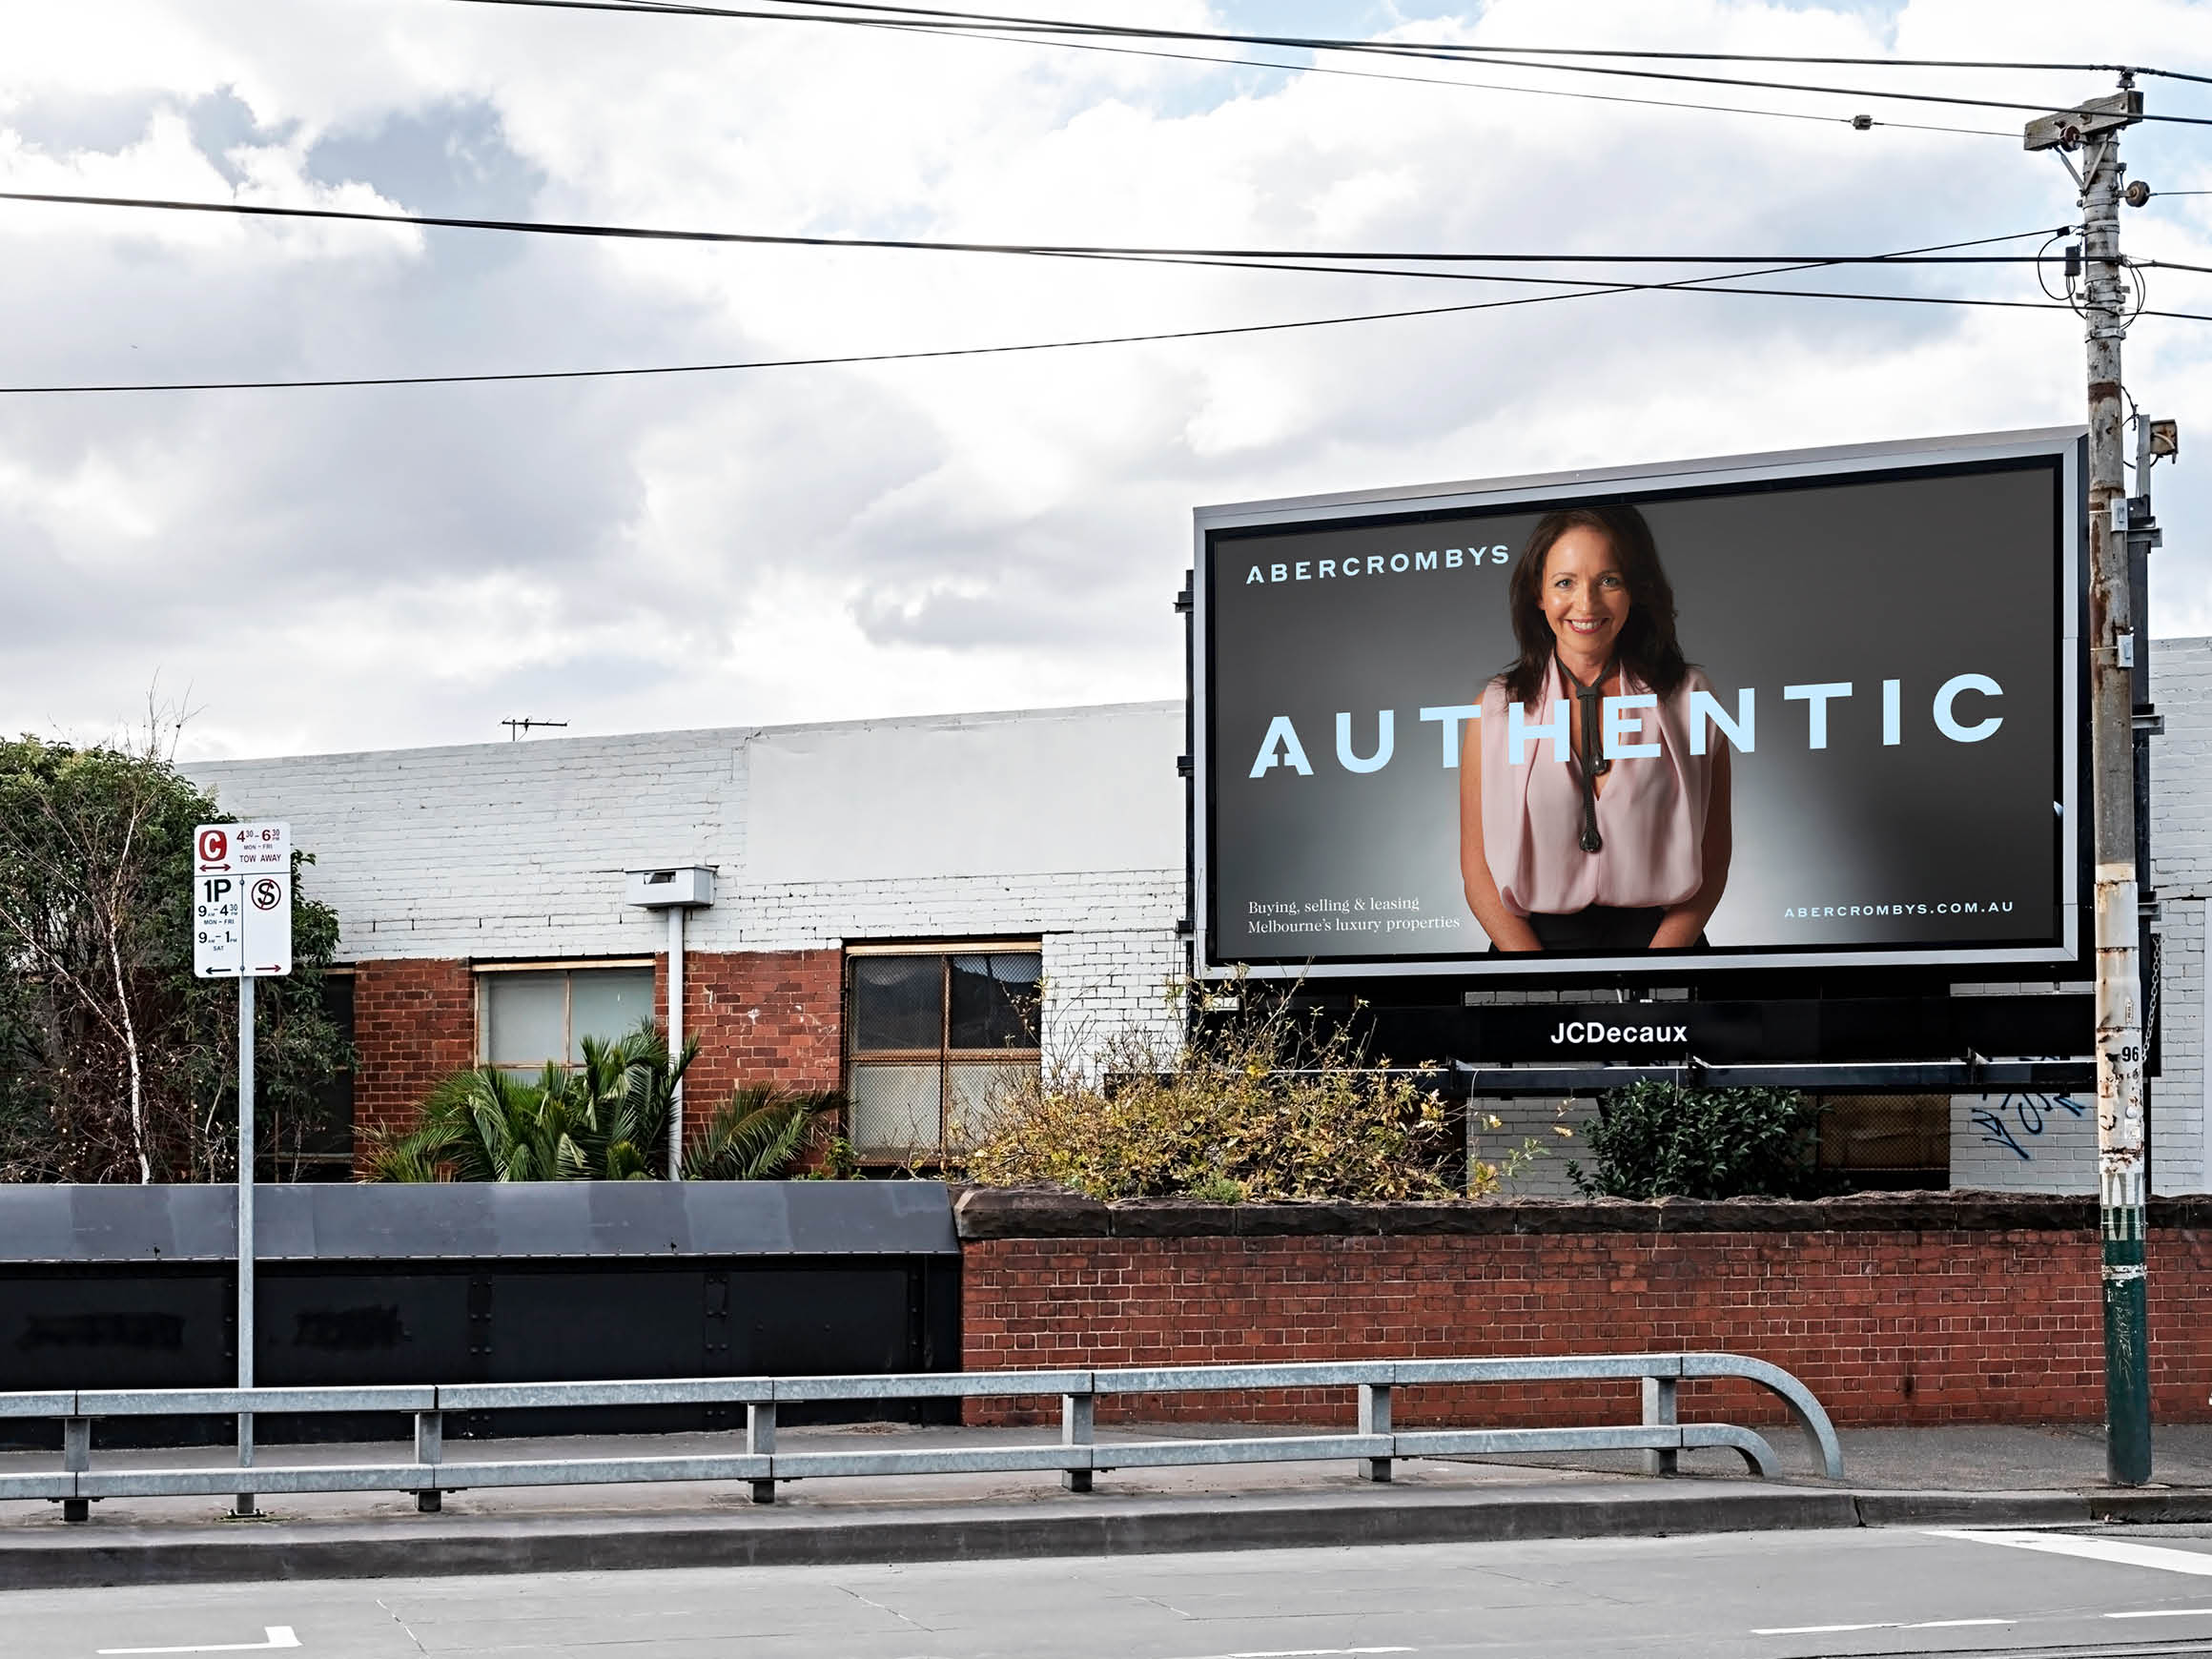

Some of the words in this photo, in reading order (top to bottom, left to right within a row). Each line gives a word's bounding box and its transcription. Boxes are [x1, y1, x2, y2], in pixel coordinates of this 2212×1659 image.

[1245, 544, 1510, 584] ABERCROMBYS
[1248, 673, 2004, 779] AUTHENTIC
[239, 854, 256, 863] TOW
[260, 853, 281, 862] AWAY
[203, 879, 232, 903] 1P
[1248, 901, 1301, 916] Buying,
[1304, 898, 1350, 913] selling
[1354, 897, 1365, 911] &
[1369, 896, 1420, 911] leasing
[1784, 901, 2014, 918] ABERCROMBYS.COM.AU
[1336, 919, 1382, 932] luxury
[1386, 915, 1461, 932] properties
[1550, 1022, 1688, 1044] JCDecaux
[2121, 1046, 2140, 1062] 96
